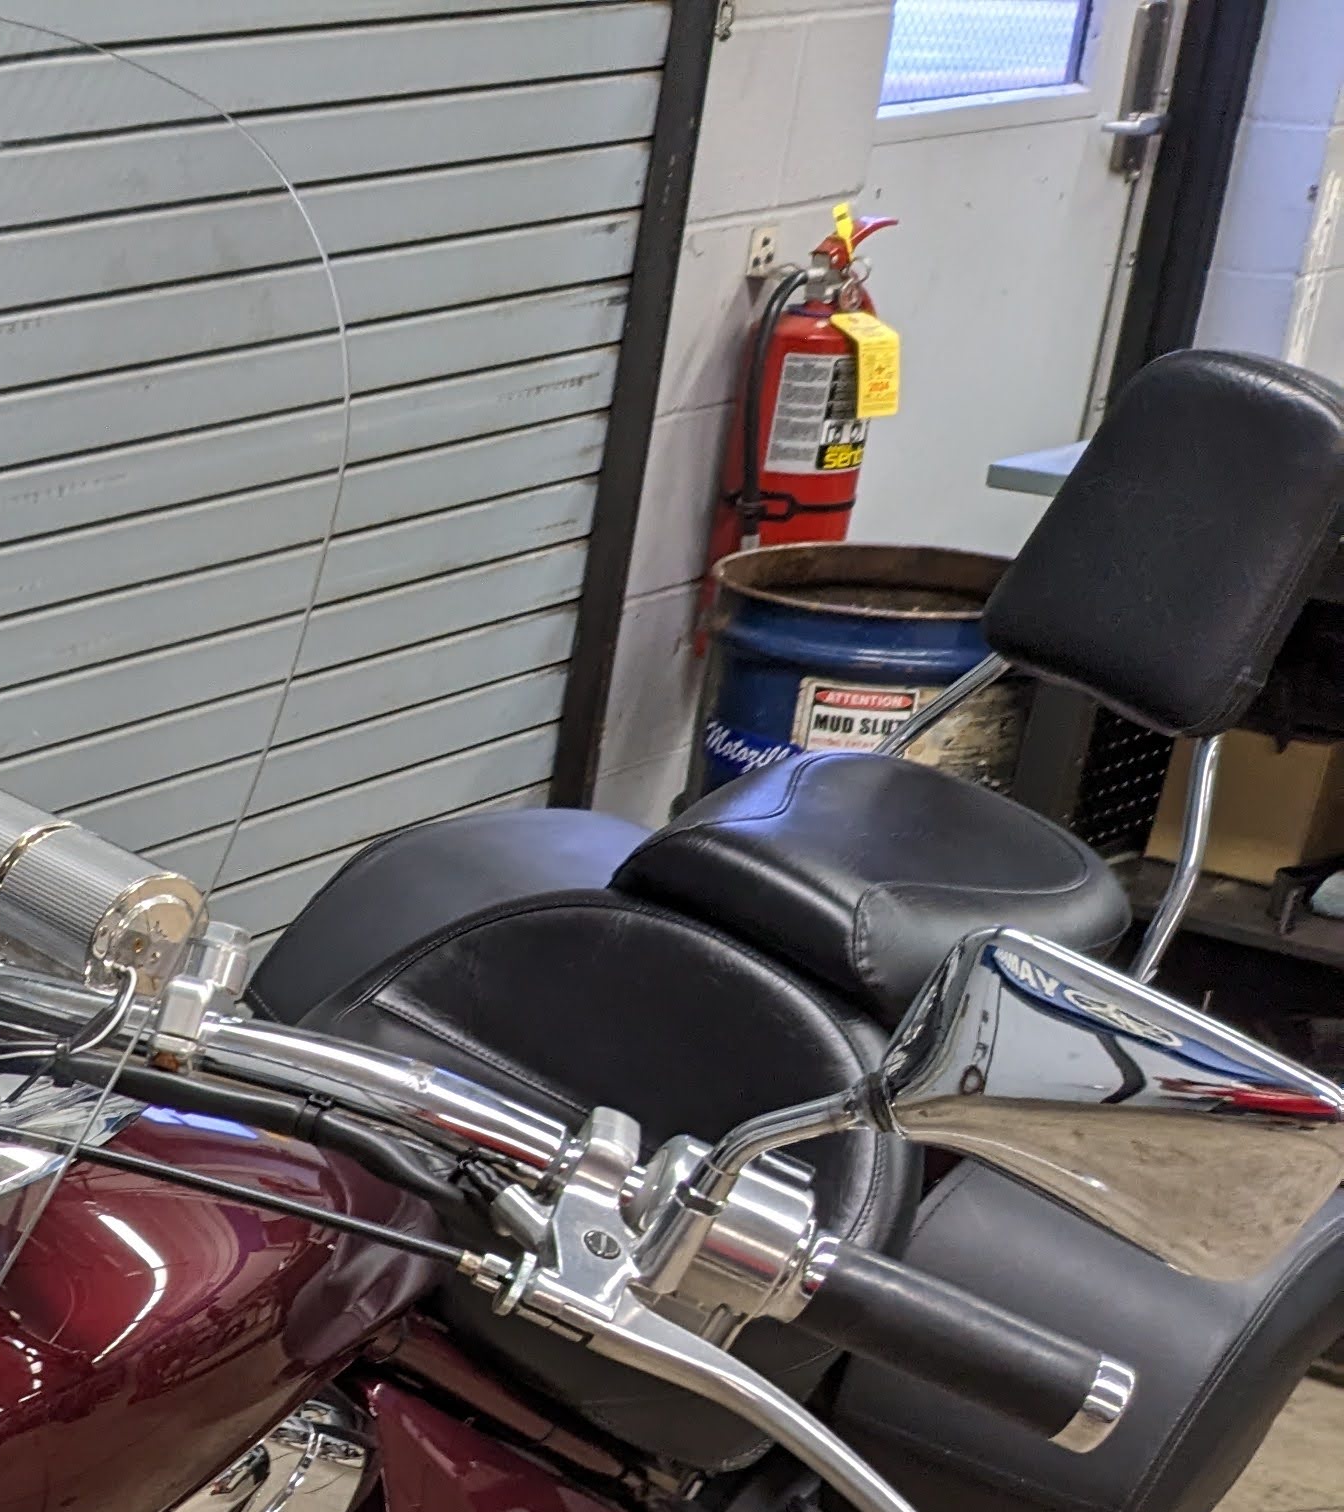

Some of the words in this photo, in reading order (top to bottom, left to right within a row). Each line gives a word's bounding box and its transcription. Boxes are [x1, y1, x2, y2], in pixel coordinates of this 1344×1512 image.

[825, 690, 903, 707] ATTENTION
[813, 713, 855, 733] MUD
[705, 721, 793, 773] Motozill
